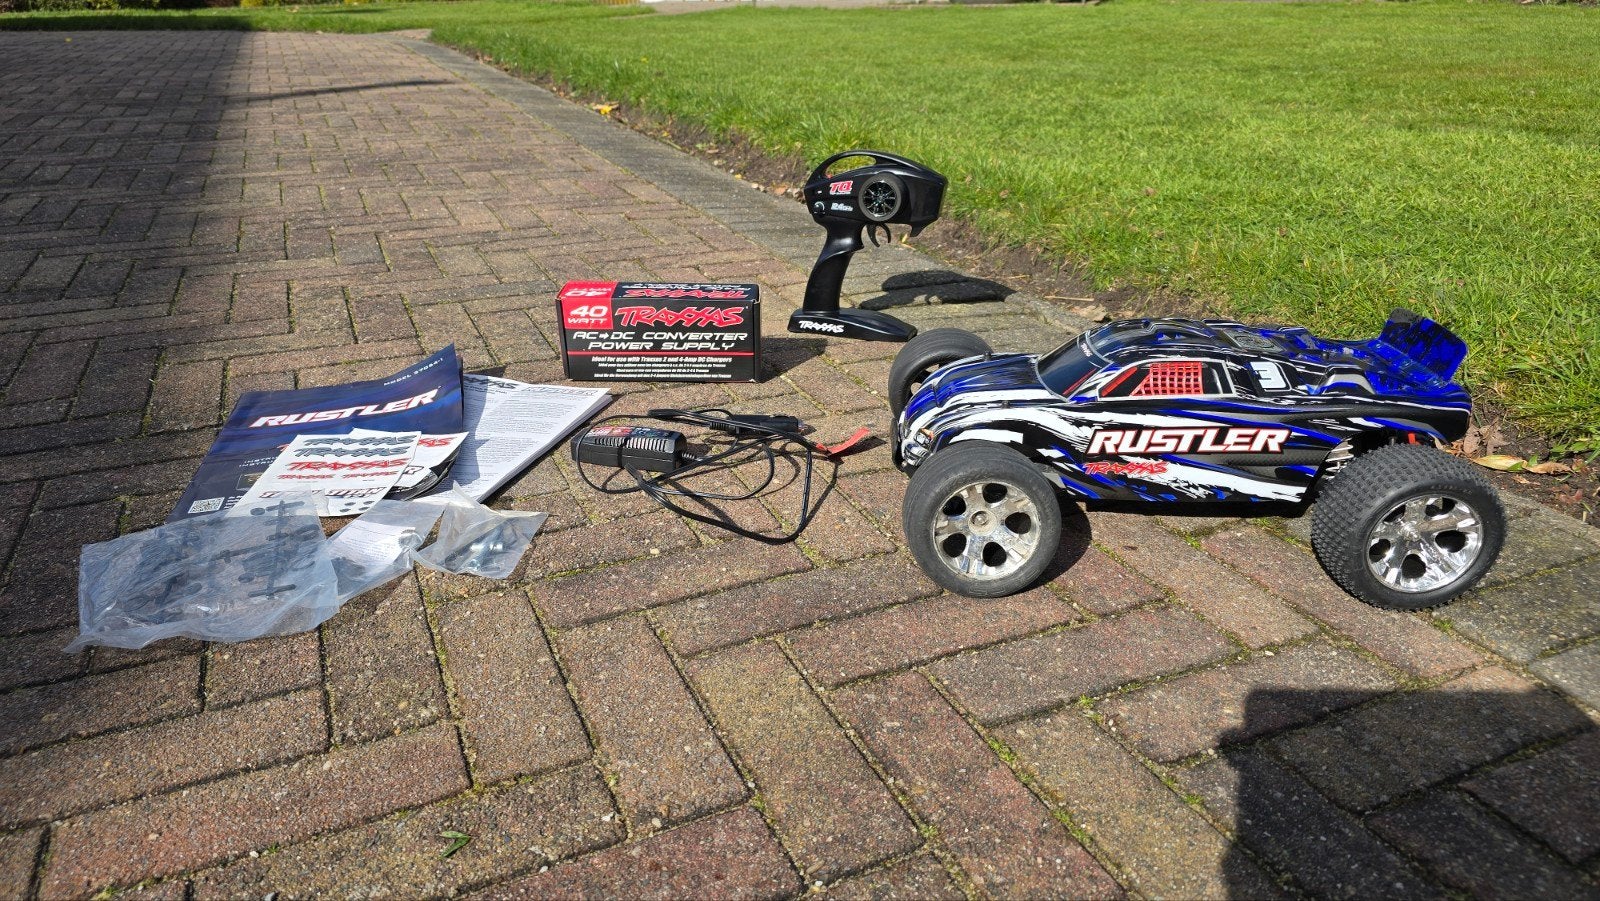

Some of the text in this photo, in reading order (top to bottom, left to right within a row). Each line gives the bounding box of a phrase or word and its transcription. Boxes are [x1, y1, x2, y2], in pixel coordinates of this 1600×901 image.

[570, 305, 609, 318] 40
[615, 305, 745, 328] TRAXXAS
[798, 320, 845, 334] TRAXXAS
[642, 331, 748, 341] CONVERTER
[587, 341, 735, 351] POWER SUPPLY
[1249, 361, 1287, 389] 3
[248, 388, 439, 428] RUSTLER
[303, 435, 417, 446] TRAXXAS
[1086, 427, 1291, 455] RUSTLER
[293, 446, 411, 457] TRAXXAS
[286, 458, 411, 471] TRAXXAS
[1083, 460, 1169, 475] TRAXXAS
